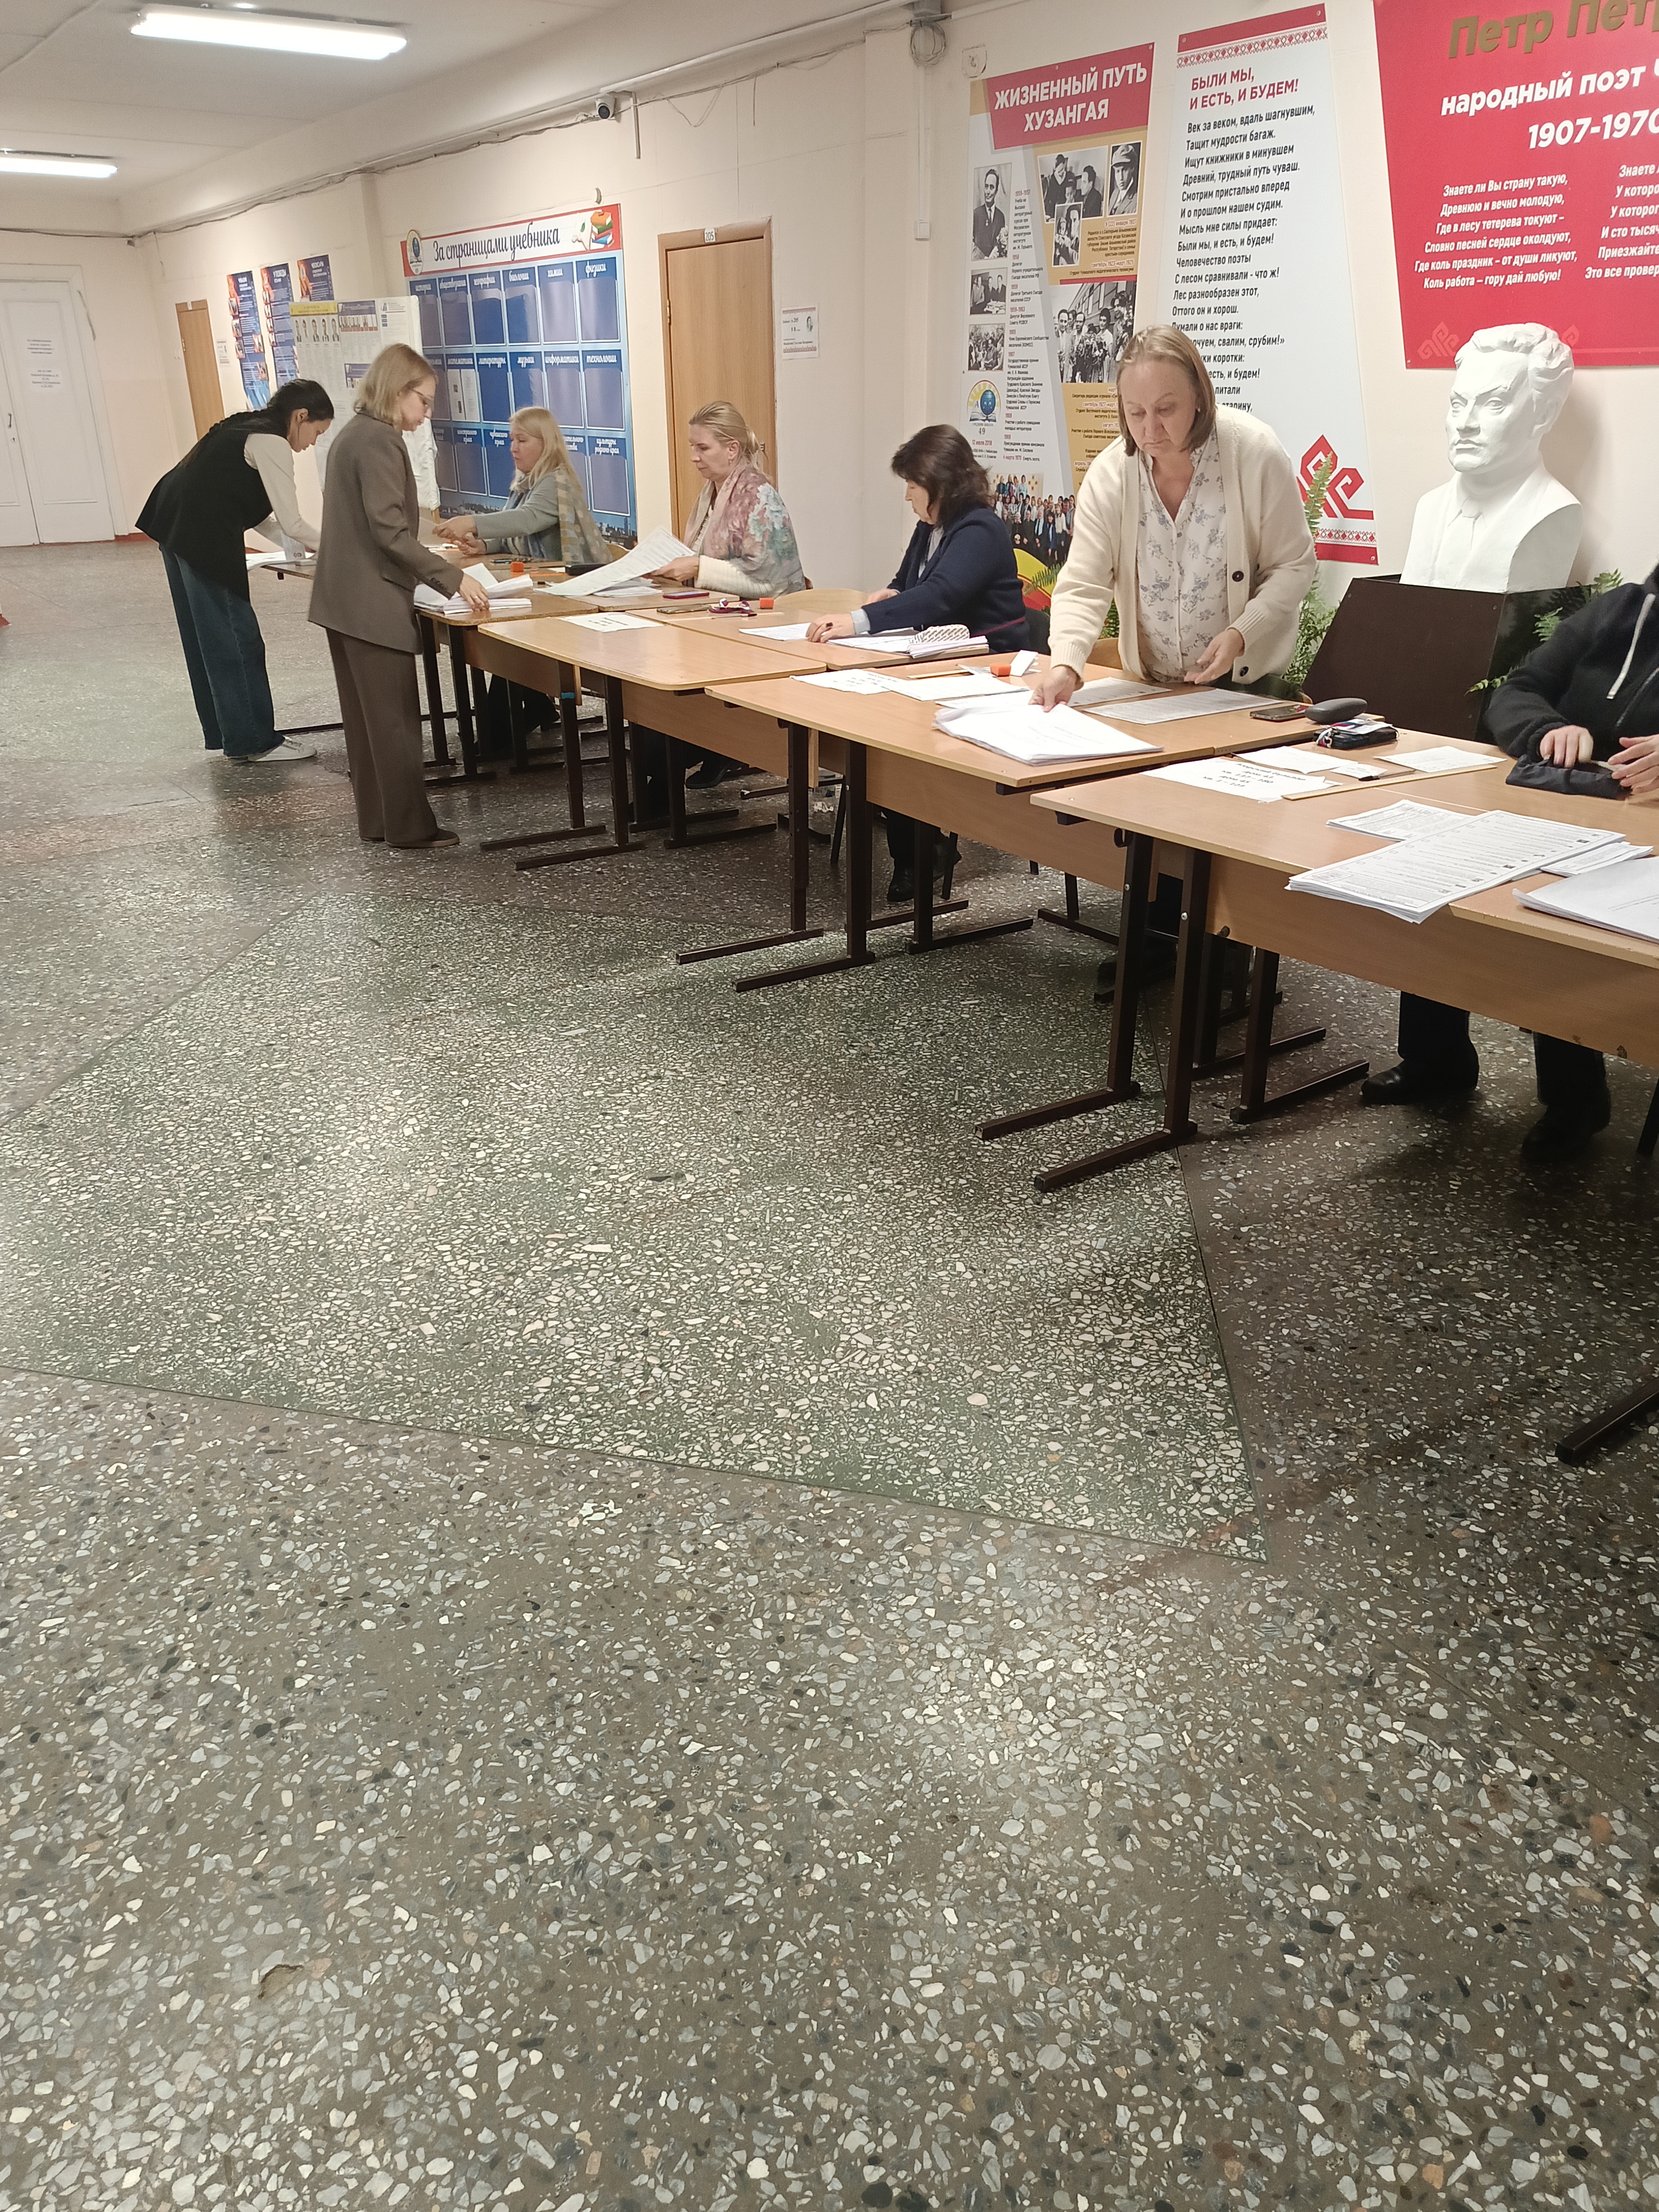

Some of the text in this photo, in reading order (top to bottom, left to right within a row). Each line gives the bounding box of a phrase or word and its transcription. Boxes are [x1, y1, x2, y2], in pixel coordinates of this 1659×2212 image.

[1449, 0, 1659, 58] Петр Пет
[994, 62, 1147, 110] ЖИЗНЕННЫЙ ПУТЬ
[1192, 67, 1254, 91] БЫЛИ МЫ,
[1190, 79, 1298, 109] И ЕСТЬ, И БУДЕМ!
[1441, 71, 1573, 117] народный
[1579, 66, 1646, 95] поэт
[1024, 98, 1108, 132] ХУЗАНГАЯ
[1188, 105, 1315, 133] Век за веком, вдаль шагнувшим,
[1529, 109, 1659, 148] 1907-1970
[1186, 129, 1275, 150] Тащит мудрости багаж.
[1185, 145, 1294, 169] Ищут книжники в минувшем
[1183, 161, 1300, 186] Древний, трудный путь чуваш.
[1619, 164, 1656, 178] Знаете
[1182, 181, 1290, 202] Смотрим пристально вперед
[1443, 174, 1568, 197] Знаете ли Вы страну такую,
[1615, 185, 1624, 198] У
[1181, 200, 1283, 218] И о прошлом нашем судим.
[1440, 194, 1564, 217] Древнюю и вечно молодую,
[1610, 206, 1618, 218] У
[1179, 217, 1277, 235] Мысль мне силы придает:
[1436, 214, 1557, 234] Где в лесу тетерева токуют
[1601, 226, 1609, 239] И
[1611, 227, 1627, 238] сто
[432, 221, 560, 268] За страницами учебника
[1178, 241, 1197, 252] Были
[1198, 239, 1212, 251] мы,
[1220, 238, 1238, 248] есть,
[1240, 238, 1244, 247] и
[1246, 233, 1274, 246] будем!
[1425, 232, 1571, 253] Словно песней сердце околдуют,
[586, 261, 606, 277] физики
[1176, 253, 1251, 268] Человечество поэты
[1415, 251, 1577, 273] Где коль праздник от души ликуют,
[1175, 267, 1279, 284] С лесом сравнивали что ж!
[1423, 269, 1561, 290] Коль работа гору дай любую!
[1585, 267, 1602, 279] Это
[1604, 267, 1622, 278] все
[1173, 286, 1259, 301] Лес разнообразен этот,
[1172, 304, 1239, 316] Оттого он и хорош.
[1199, 322, 1203, 331] о
[1206, 321, 1218, 331] нас
[1220, 320, 1243, 332] враги:
[1218, 335, 1285, 348] свалим, срубим!»
[587, 354, 617, 364] технологии
[1213, 353, 1244, 363] коротки:
[1234, 369, 1260, 379] будем!
